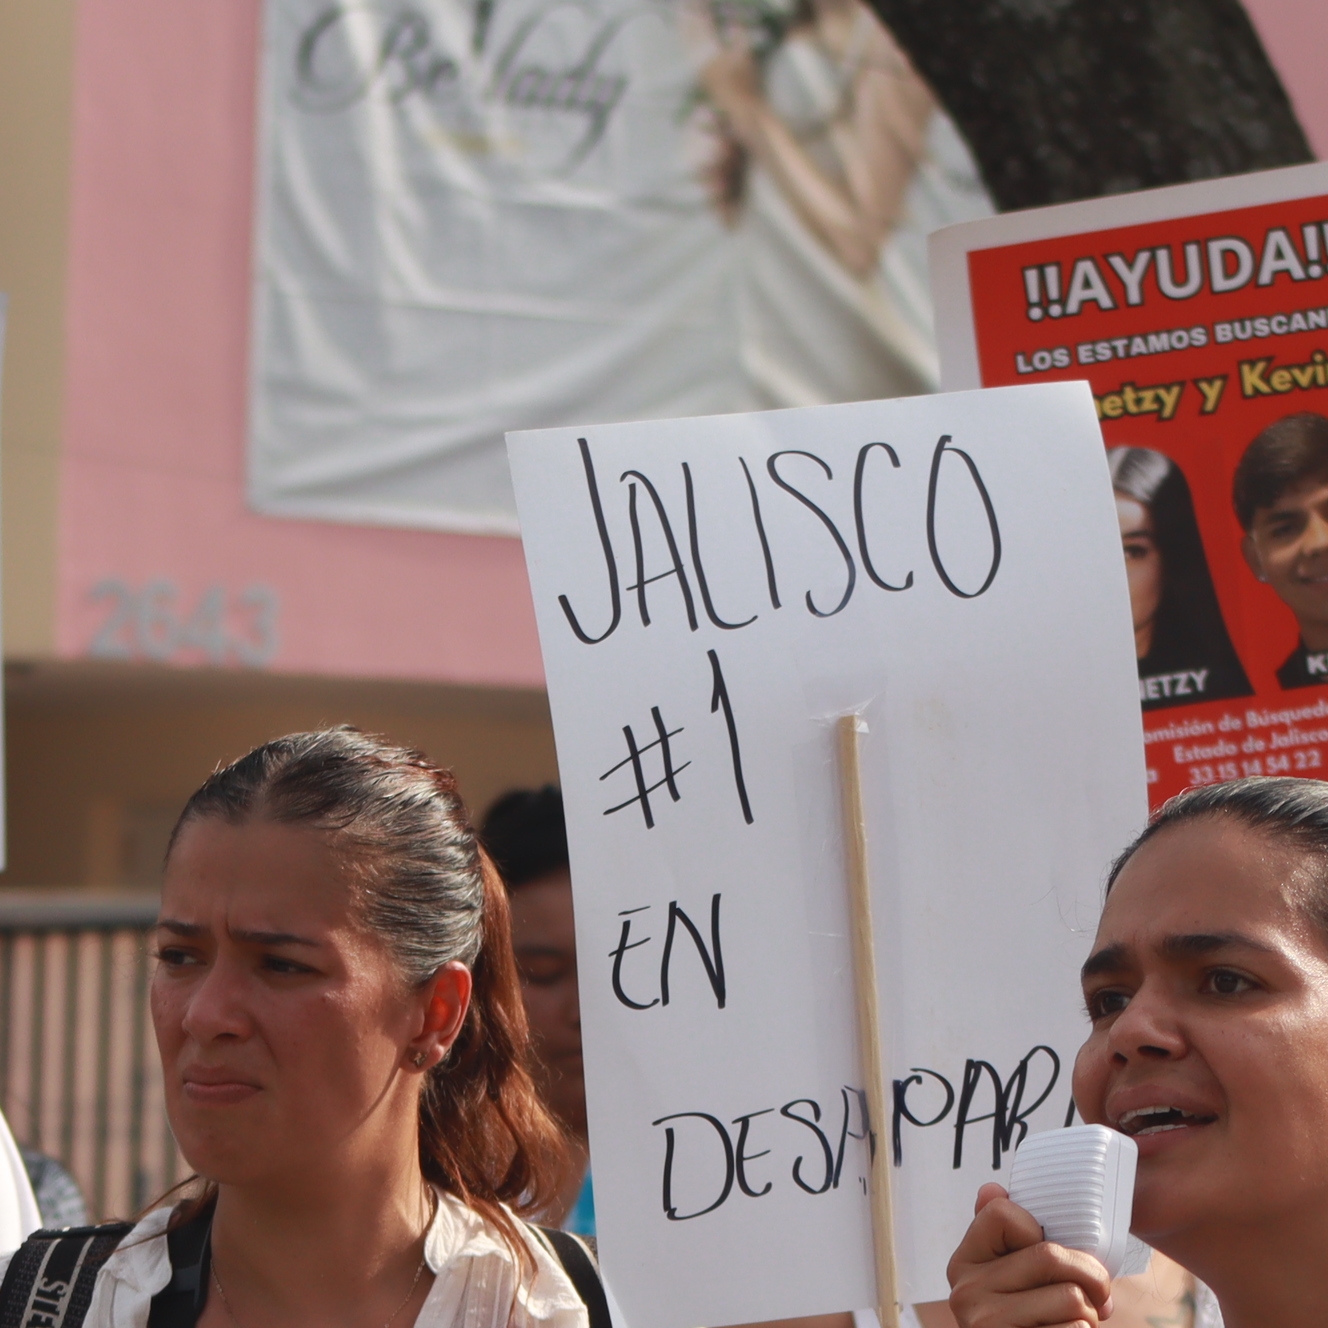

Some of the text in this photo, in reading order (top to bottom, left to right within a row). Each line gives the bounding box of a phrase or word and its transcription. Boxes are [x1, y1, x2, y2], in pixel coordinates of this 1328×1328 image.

[1015, 346, 1072, 375] LOS
[1076, 324, 1209, 365] ESTAMOS
[1094, 382, 1184, 420] etzy
[1194, 376, 1227, 415] y
[557, 434, 1003, 645] JALISCO
[1139, 669, 1209, 701] ETZY
[599, 649, 754, 829] #1
[1143, 717, 1214, 746] omisión
[1218, 711, 1244, 734] de
[1174, 740, 1237, 764] Estado
[1242, 735, 1266, 754] de
[1268, 755, 1291, 774] 54
[1295, 750, 1321, 770] 22
[609, 892, 726, 1010] EN
[652, 1045, 1076, 1221] DESAPAR
